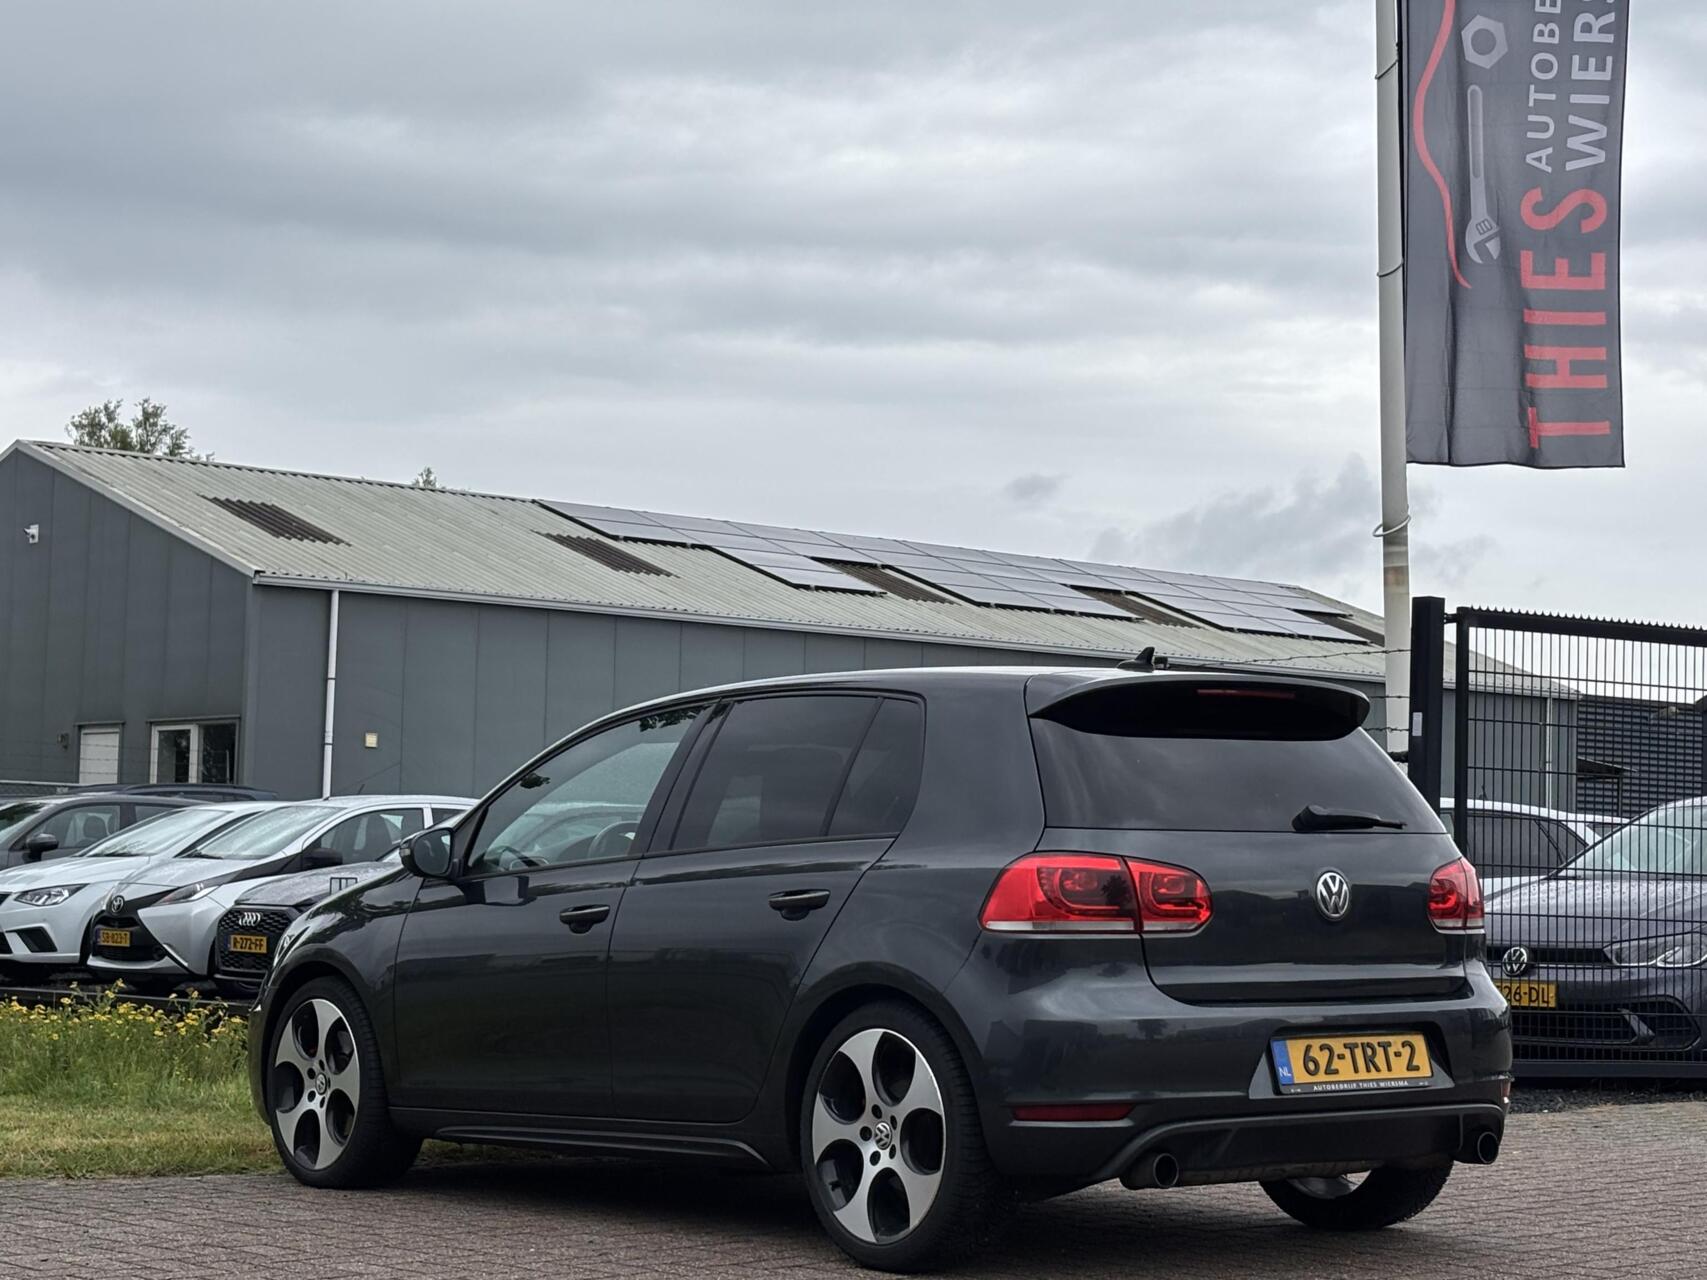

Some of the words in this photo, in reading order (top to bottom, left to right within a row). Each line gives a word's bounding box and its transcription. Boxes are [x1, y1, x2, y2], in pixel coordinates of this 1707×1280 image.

[1566, 0, 1616, 171] WIER
[1520, 186, 1611, 449] THIES
[1278, 1066, 1292, 1077] NL
[1303, 1040, 1420, 1076] 62-TRT-2
[1359, 1080, 1377, 1088] THIES
